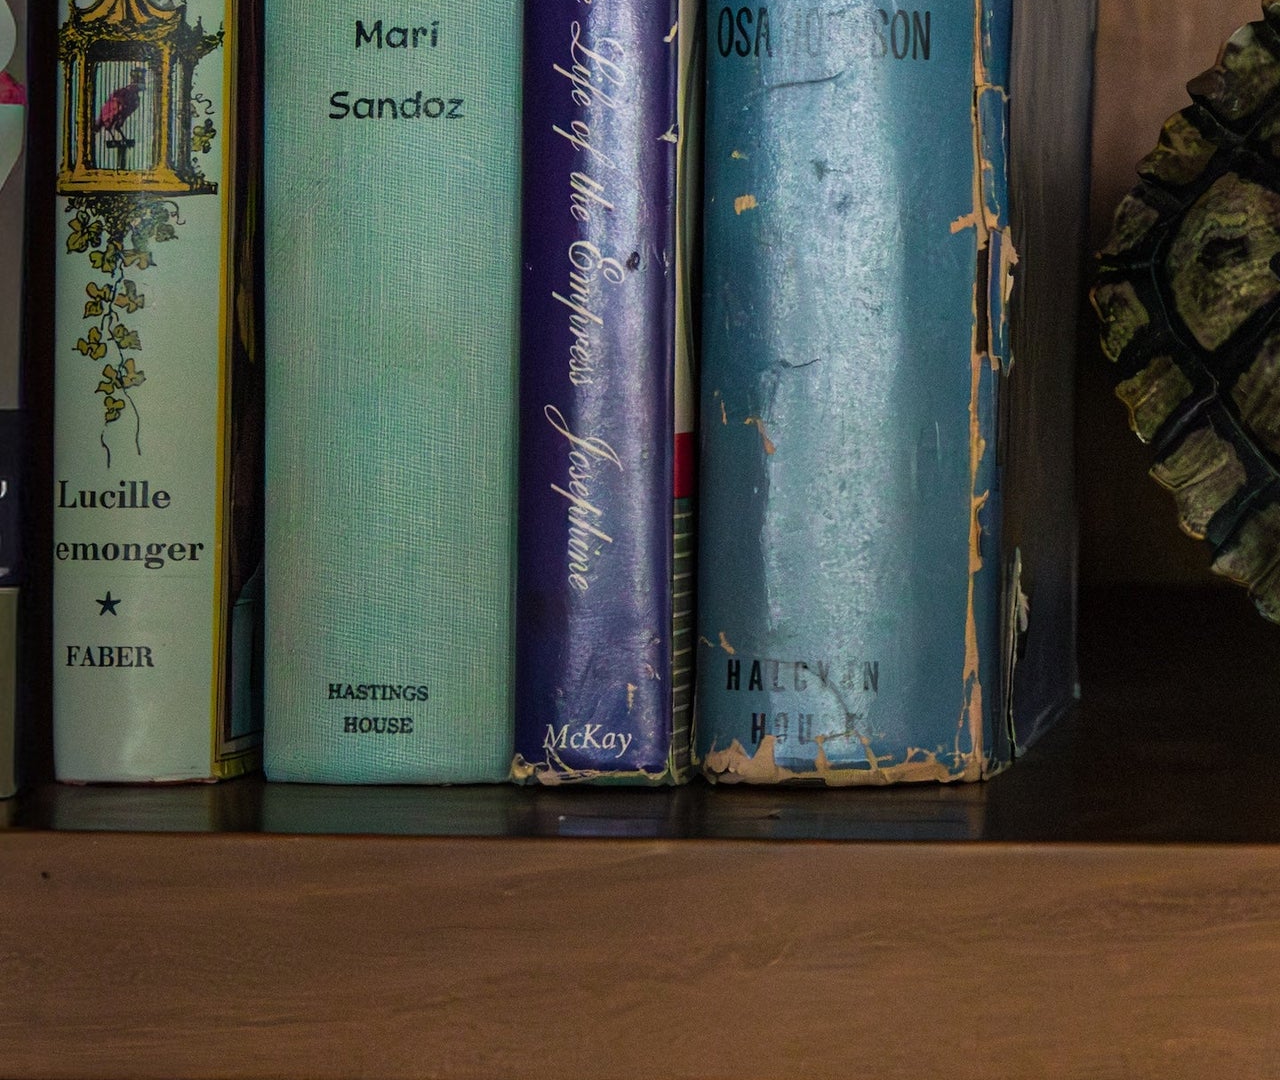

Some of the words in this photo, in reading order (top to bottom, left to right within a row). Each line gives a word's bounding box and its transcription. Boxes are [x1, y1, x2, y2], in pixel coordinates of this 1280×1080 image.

[354, 19, 440, 49] Mari
[717, 5, 773, 59] OSA
[553, 20, 626, 110] Life
[328, 90, 465, 120] Sandoz
[552, 119, 617, 171] of
[570, 171, 615, 222] the
[552, 240, 625, 385] Empress
[58, 480, 172, 509] Lucille
[544, 404, 624, 592] Josephine
[66, 645, 154, 668] FABER
[328, 683, 429, 702] HASTINGS
[343, 716, 414, 735] HOUSE
[543, 723, 633, 758] McKay
